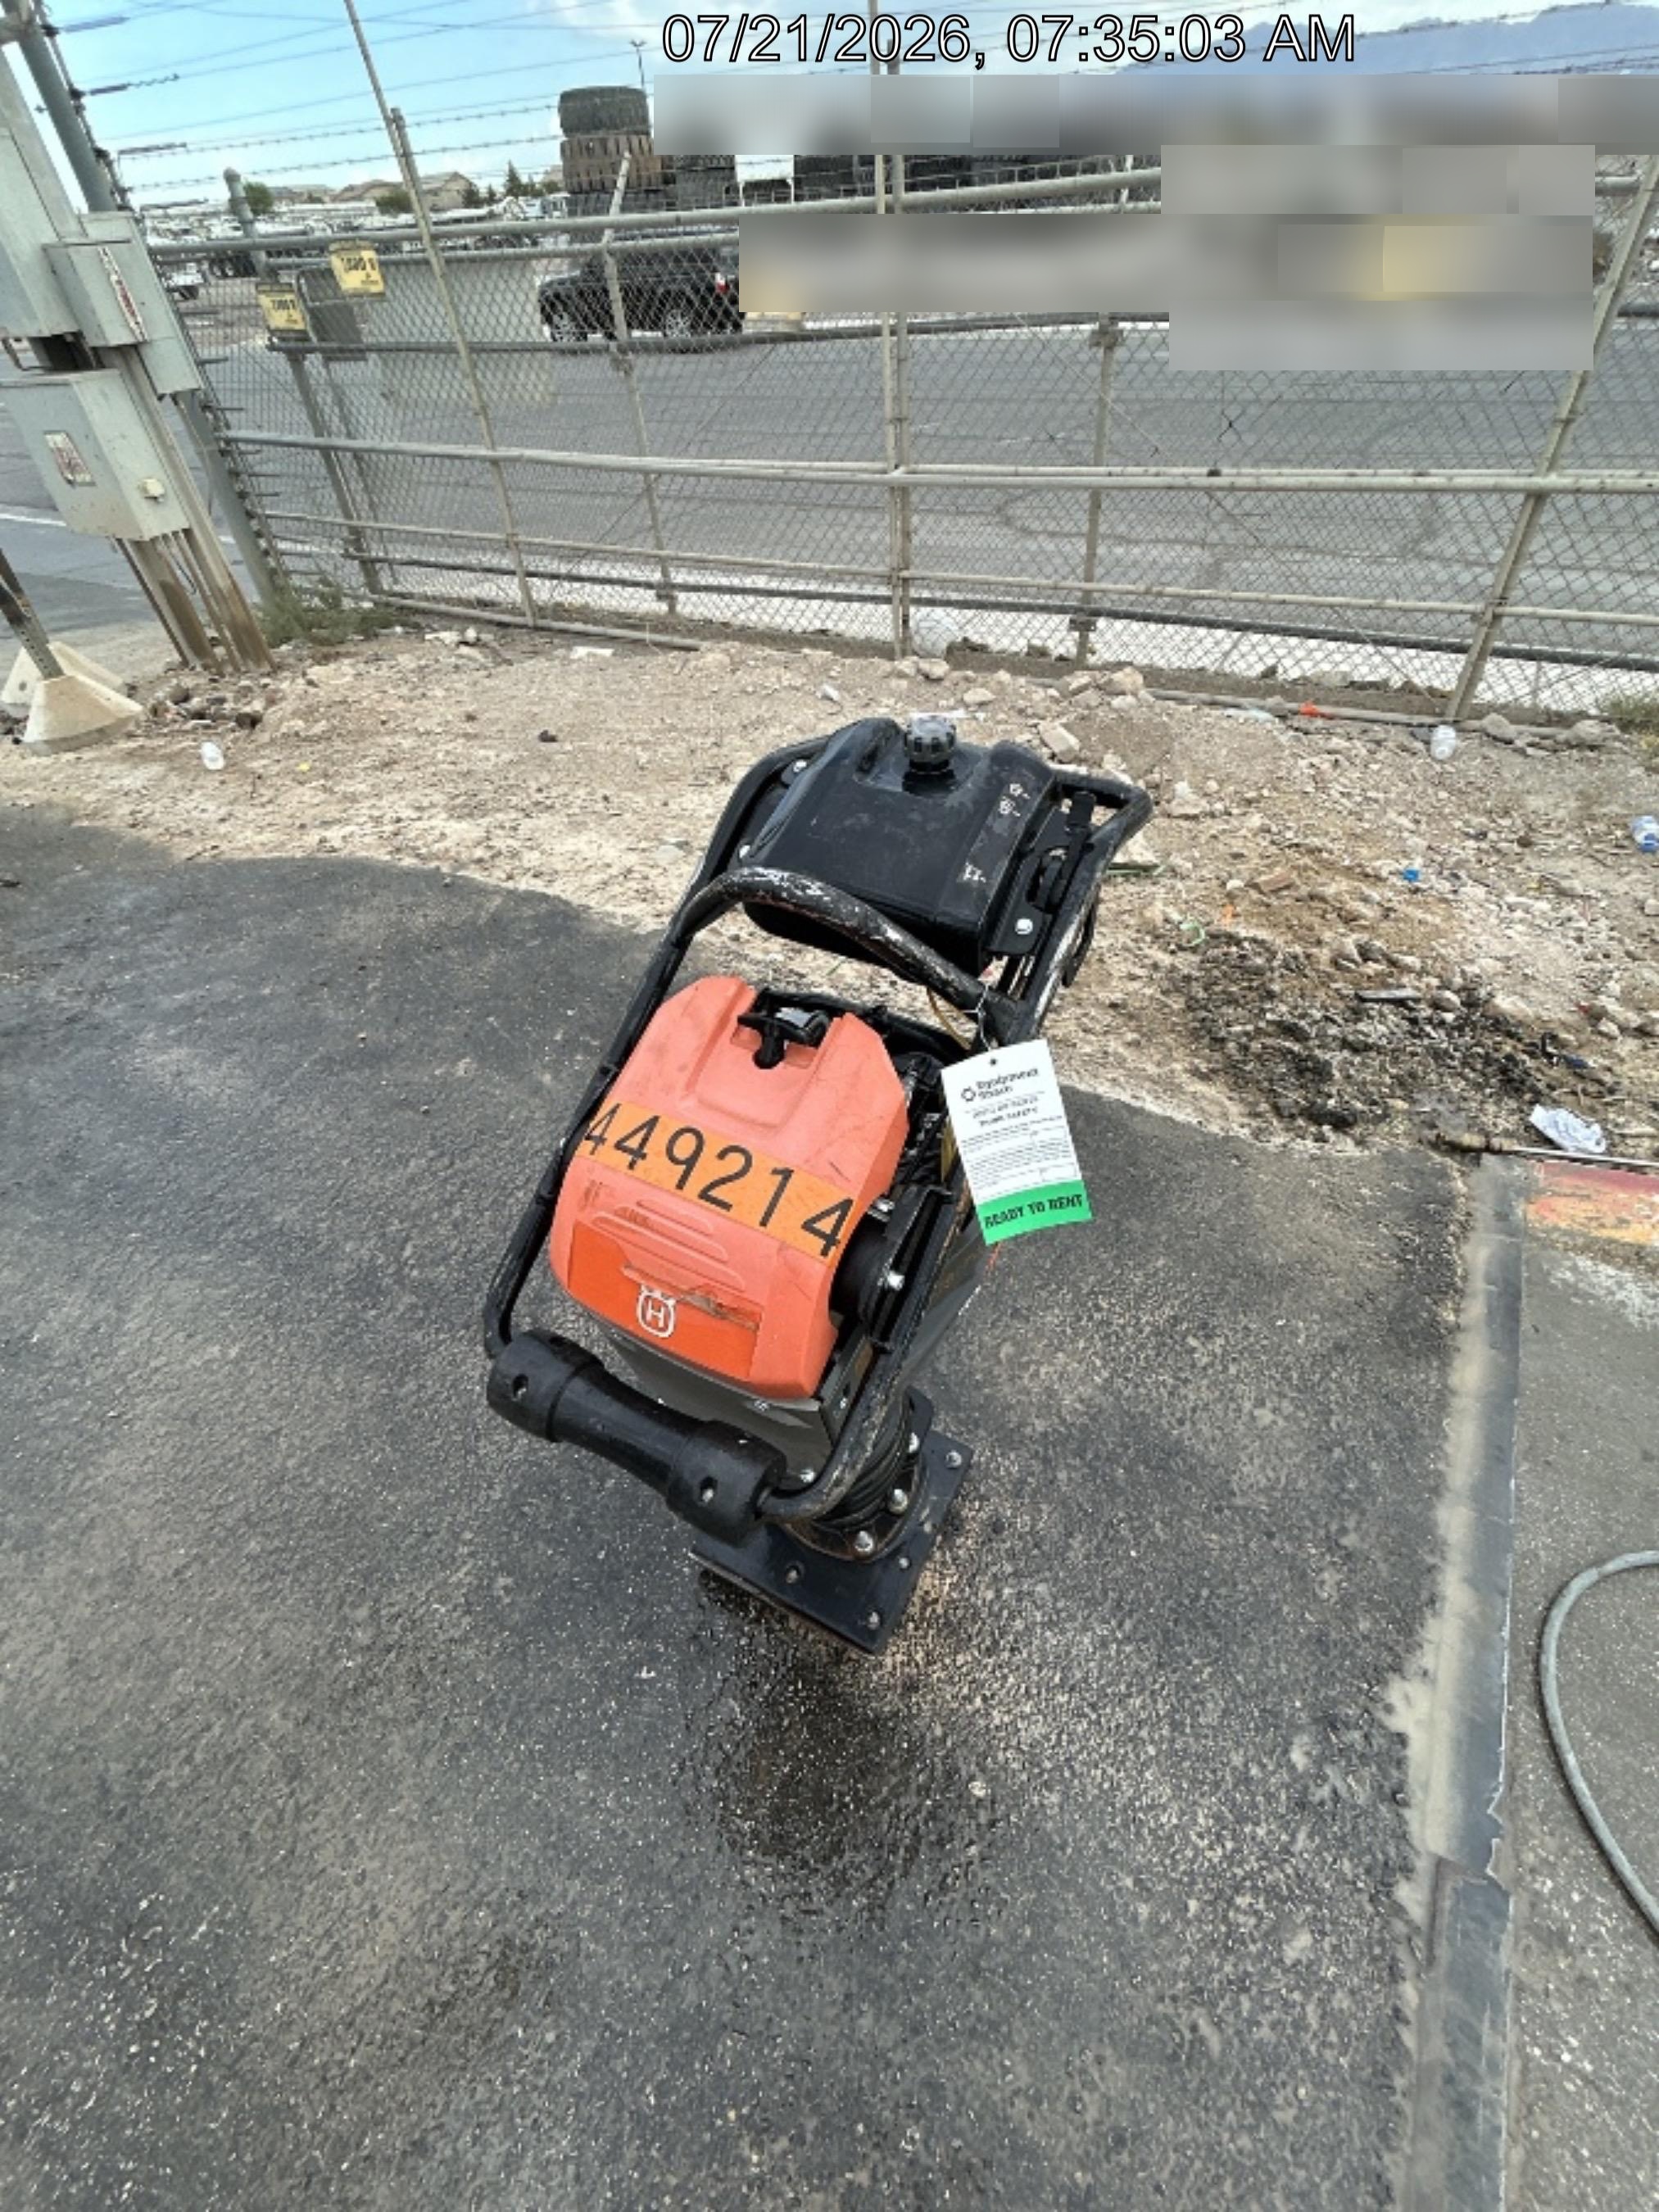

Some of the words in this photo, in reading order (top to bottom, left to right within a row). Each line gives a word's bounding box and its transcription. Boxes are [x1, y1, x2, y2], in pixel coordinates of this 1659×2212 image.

[584, 1103, 854, 1257] 449214
[985, 1207, 1024, 1229] READY
[1027, 1200, 1045, 1215] TO
[1047, 1194, 1083, 1211] RENT
